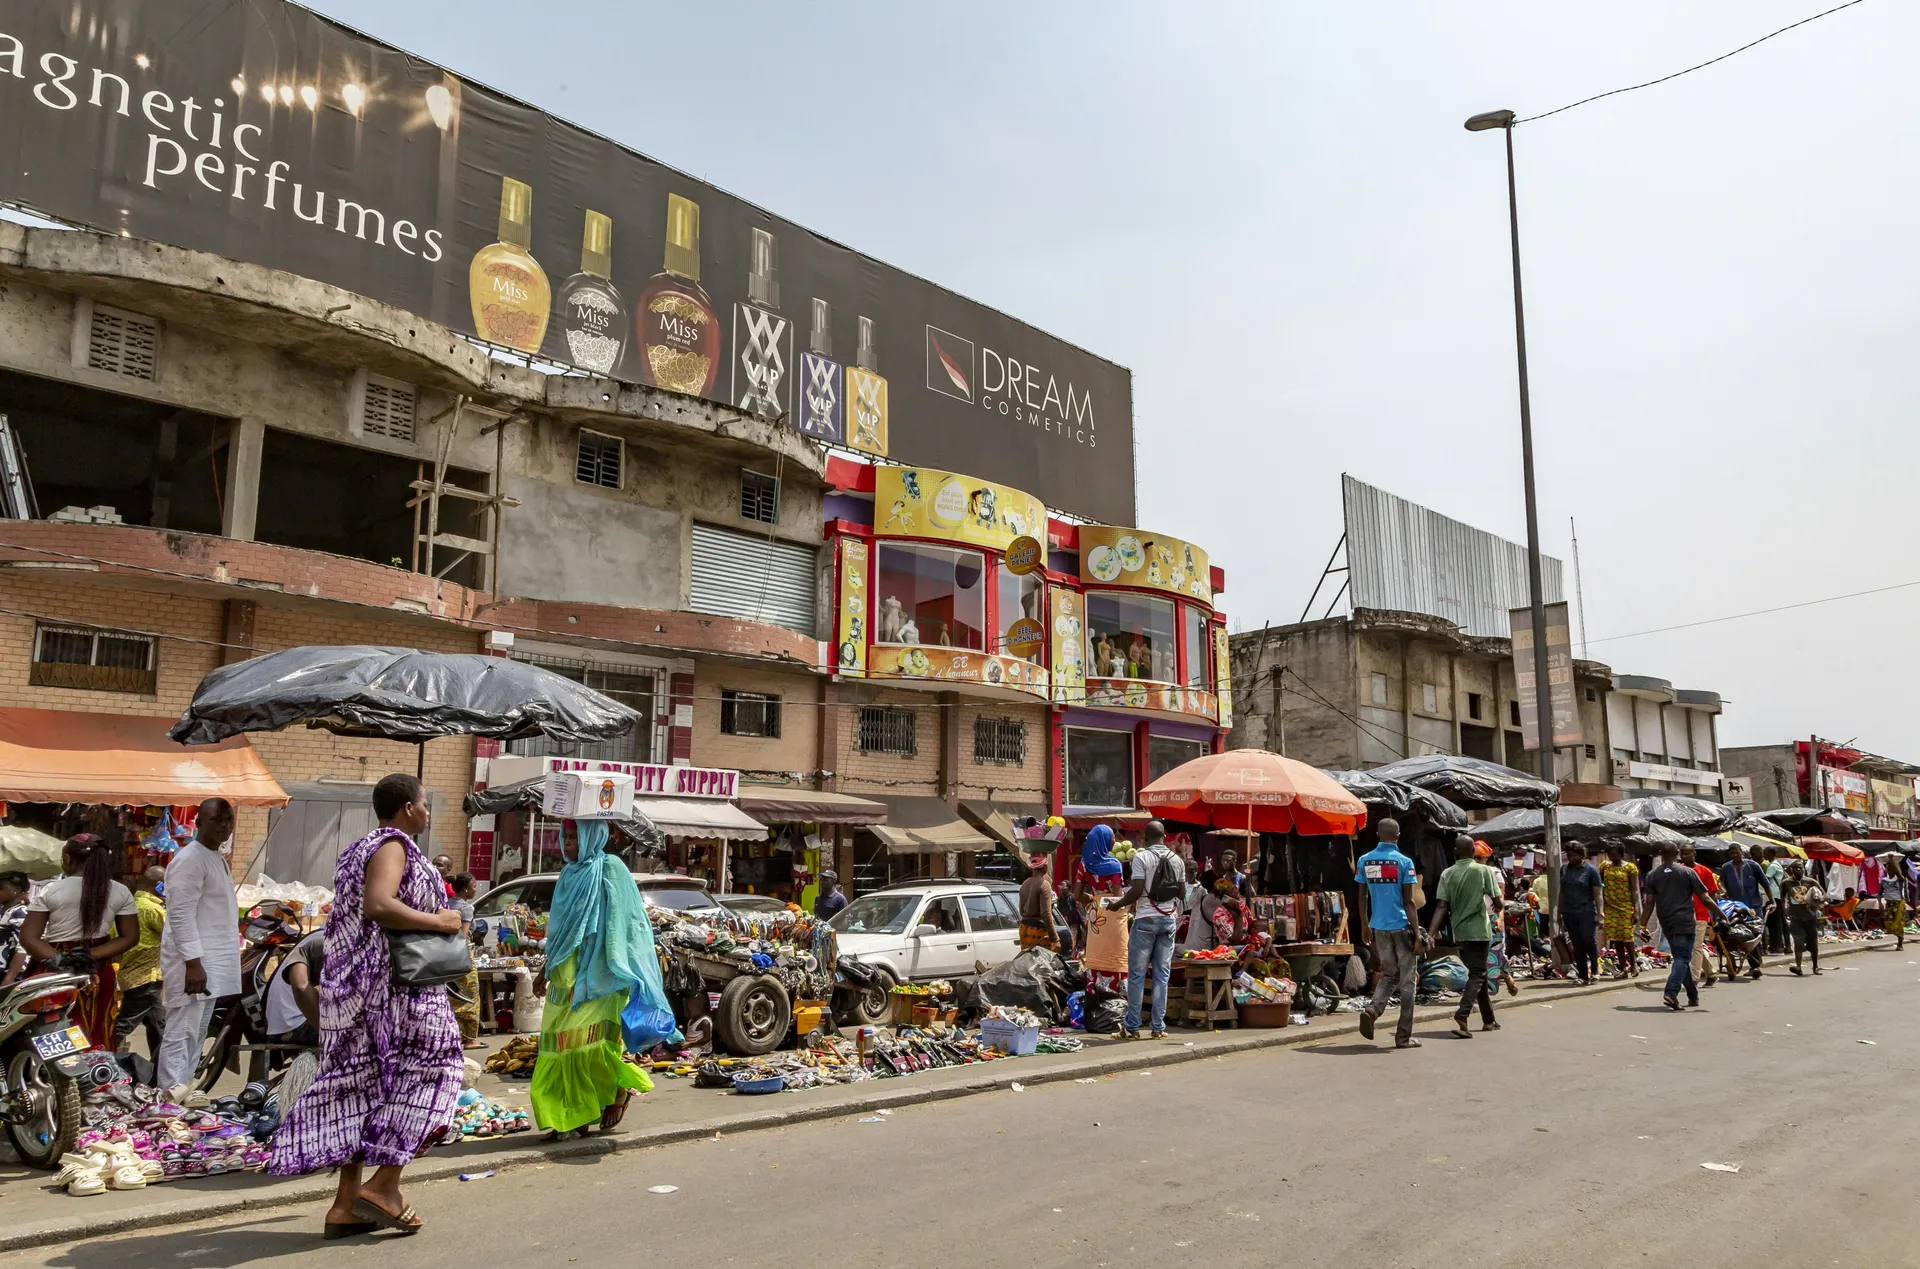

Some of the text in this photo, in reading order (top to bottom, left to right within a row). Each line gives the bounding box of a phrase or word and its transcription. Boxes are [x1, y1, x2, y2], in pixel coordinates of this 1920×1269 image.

[143, 133, 443, 262] perfumes
[493, 278, 528, 301] Miss
[577, 305, 609, 328] Miss
[660, 313, 699, 341] Miss
[666, 333, 682, 344] plum
[748, 361, 779, 385] VIP
[983, 347, 1094, 430] DREAM
[810, 395, 833, 412] VIP
[857, 410, 878, 426] VIP
[983, 395, 1096, 448] COSMETICS
[1009, 547, 1036, 560] GALERIE
[952, 656, 969, 668] BB
[935, 665, 979, 678] d'honneur
[676, 769, 737, 797] SUPPLY
[1148, 791, 1190, 803] Kash Kash
[1214, 791, 1282, 802] Kash Kash
[41, 1040, 75, 1057] 5402
